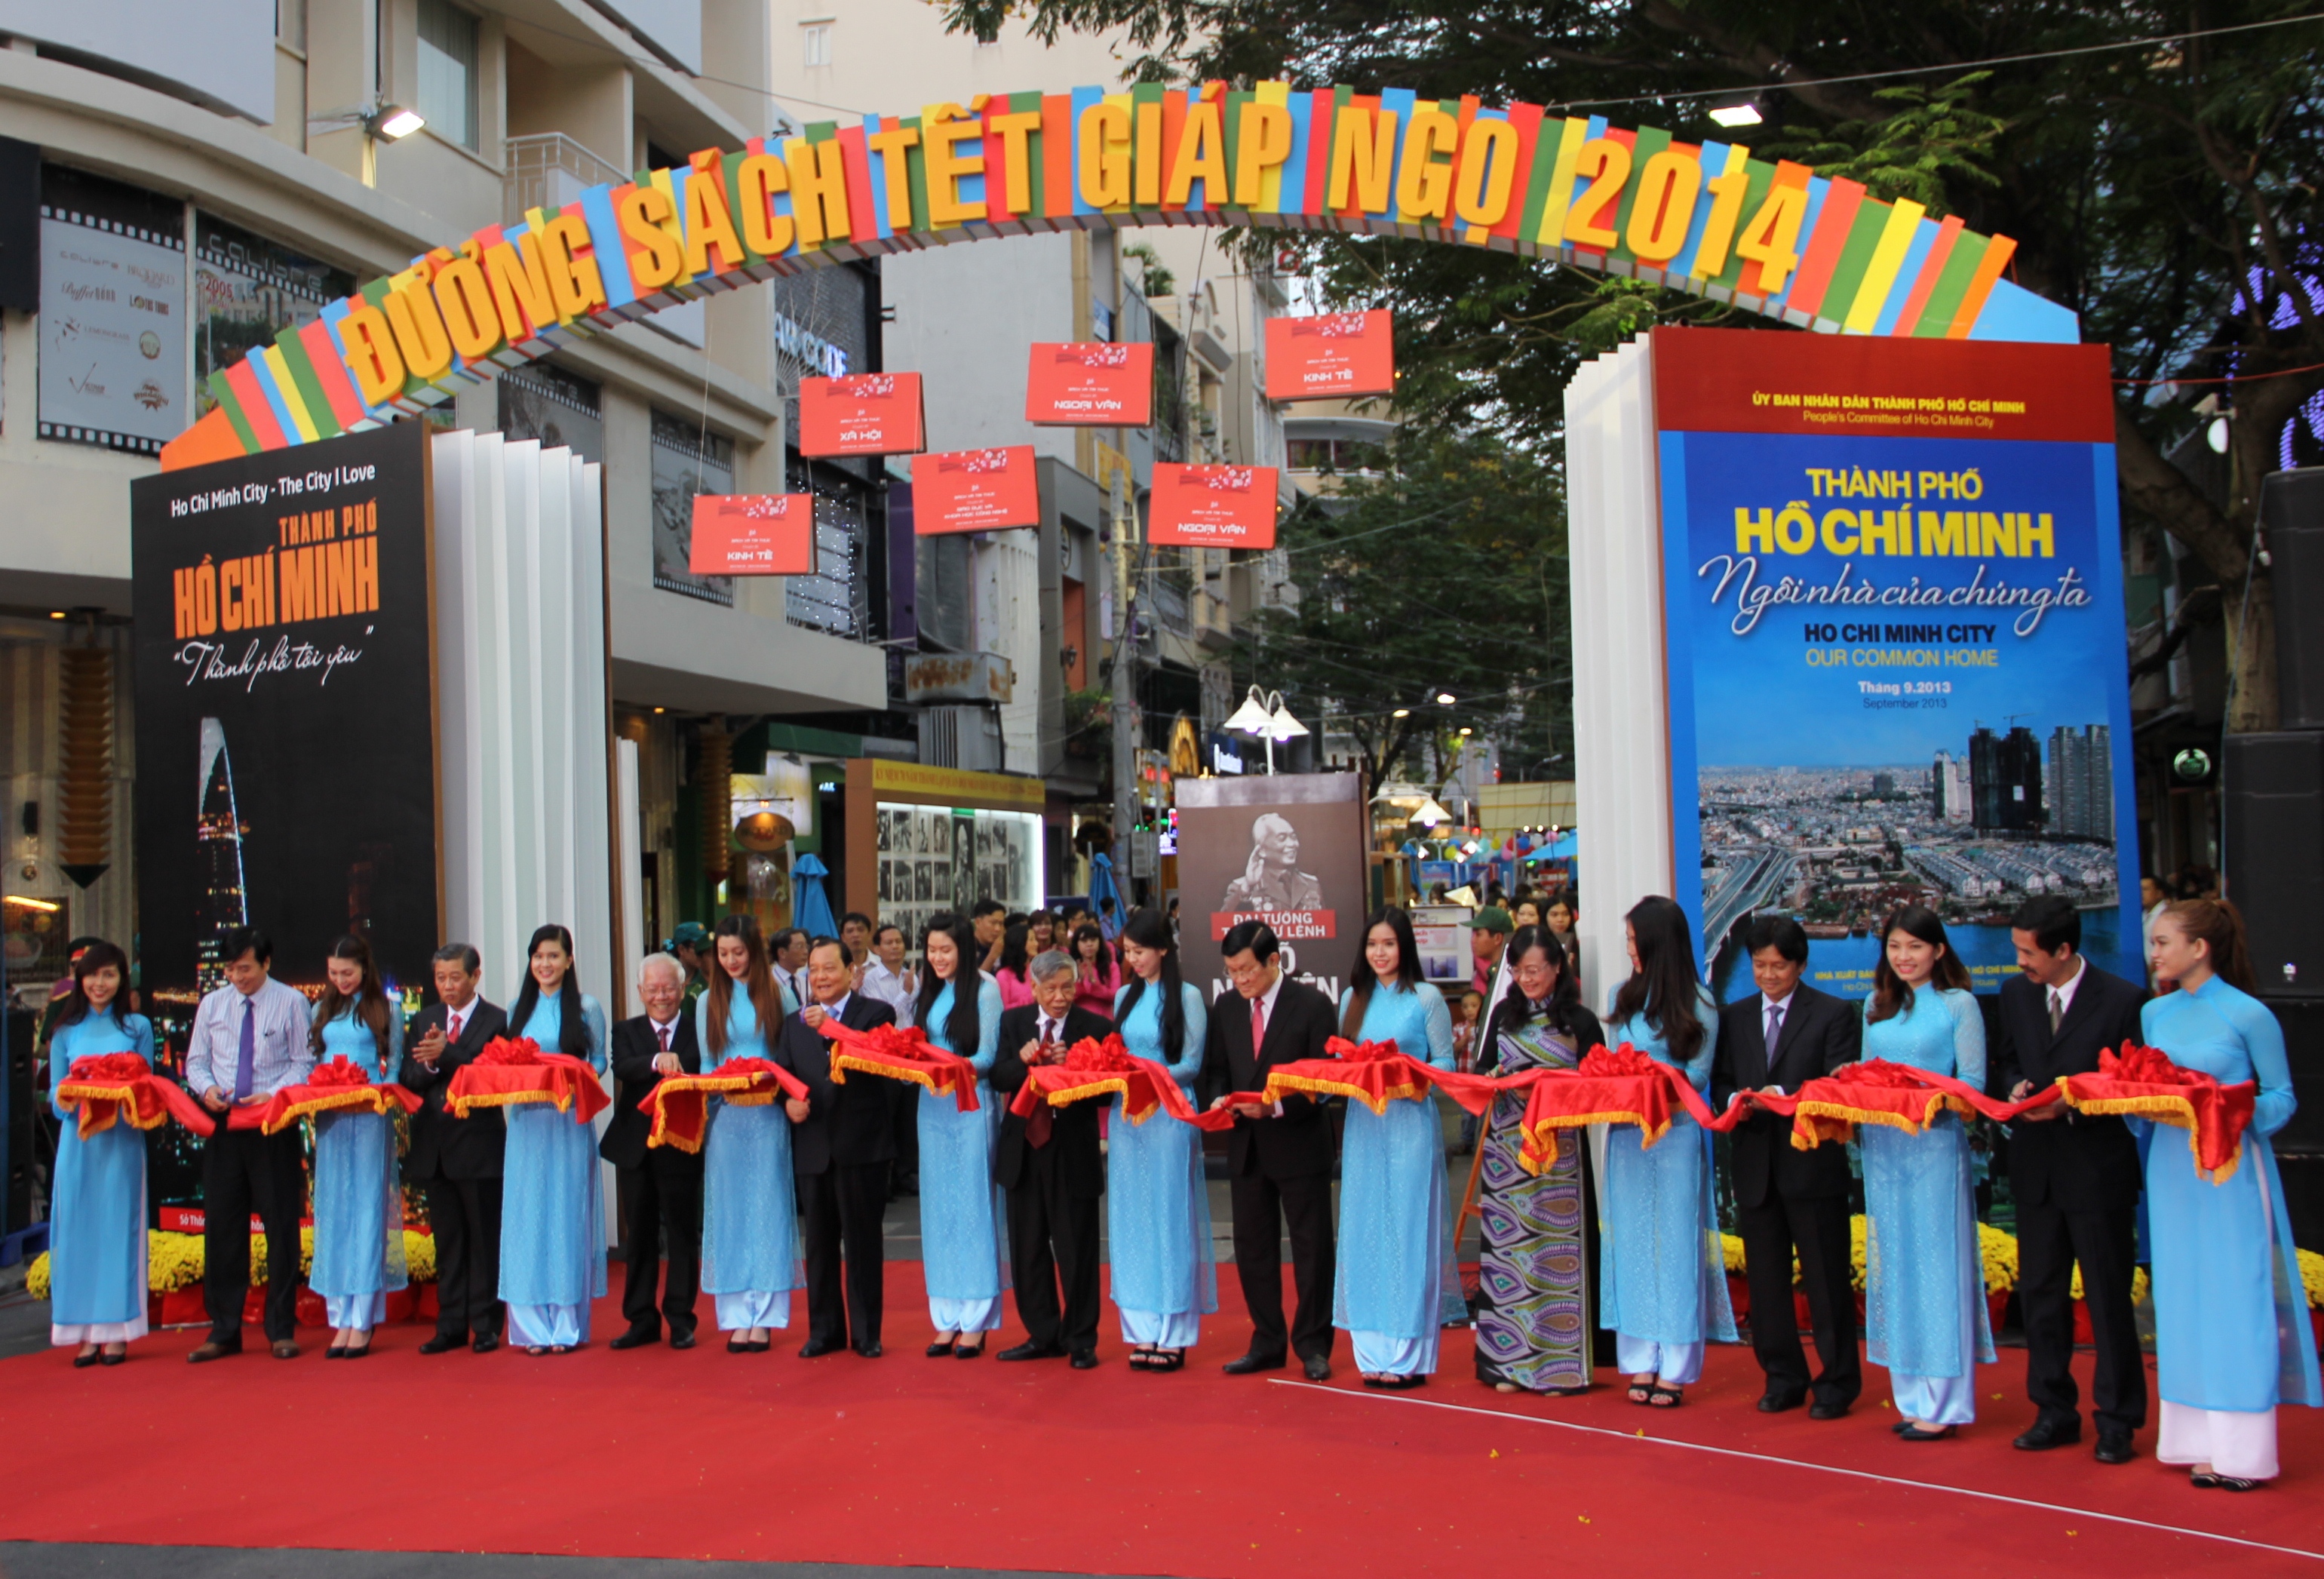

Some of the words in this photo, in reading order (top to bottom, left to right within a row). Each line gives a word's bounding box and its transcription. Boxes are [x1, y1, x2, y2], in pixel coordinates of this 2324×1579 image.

[336, 214, 604, 407] ĐƯỜNG
[620, 139, 850, 288] SÁCH
[869, 94, 1042, 229] TẾT
[1078, 83, 1293, 207] GIÁP
[1328, 105, 1519, 246] NGỌ
[1564, 137, 1809, 293] 2014
[1303, 372, 1332, 382] KINH
[1054, 400, 1092, 412] NGOẠI
[1752, 390, 1771, 406] ỦY
[1773, 394, 1801, 407] BAN
[1803, 393, 1839, 407] NHÂN
[1842, 394, 1870, 409] DÂN
[1871, 395, 1916, 410] THÀNH
[1917, 396, 1945, 411] PHỐ
[1947, 397, 1966, 412] HỒ
[1968, 398, 1991, 413] CHÍ
[1992, 401, 2025, 414] MINH
[1803, 410, 1845, 424] People's
[1847, 411, 1901, 425] Committee
[1902, 413, 1912, 424] of
[1914, 413, 1929, 425] Ho
[1930, 413, 1948, 425] Chi
[1949, 415, 1973, 426] Minh
[1974, 415, 1994, 429] City
[860, 429, 882, 441] HỘI
[171, 499, 189, 518] Ho
[190, 493, 209, 514] Chi
[211, 487, 241, 509] Minh
[243, 483, 269, 505] City
[278, 476, 303, 496] The
[306, 471, 332, 493] City
[335, 467, 339, 487] I
[342, 464, 376, 484] Love
[1805, 465, 1912, 499] THÀNH
[1918, 468, 1983, 500] PHỐ
[278, 511, 336, 547] THÀNH
[342, 496, 377, 536] PHỐ
[1177, 523, 1217, 535] NGOẠI
[1734, 500, 1816, 555] HỒ
[1820, 502, 1913, 556] CHÍ
[1918, 511, 2055, 558] MINH
[727, 551, 754, 561] KINH
[173, 553, 217, 639] HỒ
[220, 545, 275, 631] CHÍ
[279, 536, 379, 624] MINH
[1698, 554, 1808, 634] Ngôi
[1806, 562, 1882, 605] nhà
[1881, 576, 1949, 605] của
[1948, 564, 2057, 637] chúng
[2055, 567, 2093, 606] ta
[1804, 623, 1837, 642] HO
[1841, 624, 1880, 643] CHI
[1885, 624, 1942, 644] MINH
[1947, 625, 1997, 644] CITY
[247, 634, 293, 693] phố
[291, 641, 324, 669] tôi
[1805, 648, 1848, 667] OUR
[1852, 649, 1941, 667] COMMON
[1945, 649, 1998, 667] HOME
[1858, 680, 1901, 696] Tháng
[1903, 680, 1952, 694] 9.2013
[1863, 697, 1919, 710] September
[1921, 698, 1947, 708] 2013
[1262, 911, 1313, 924] TƯỚNG
[1287, 924, 1326, 938] LỆNH
